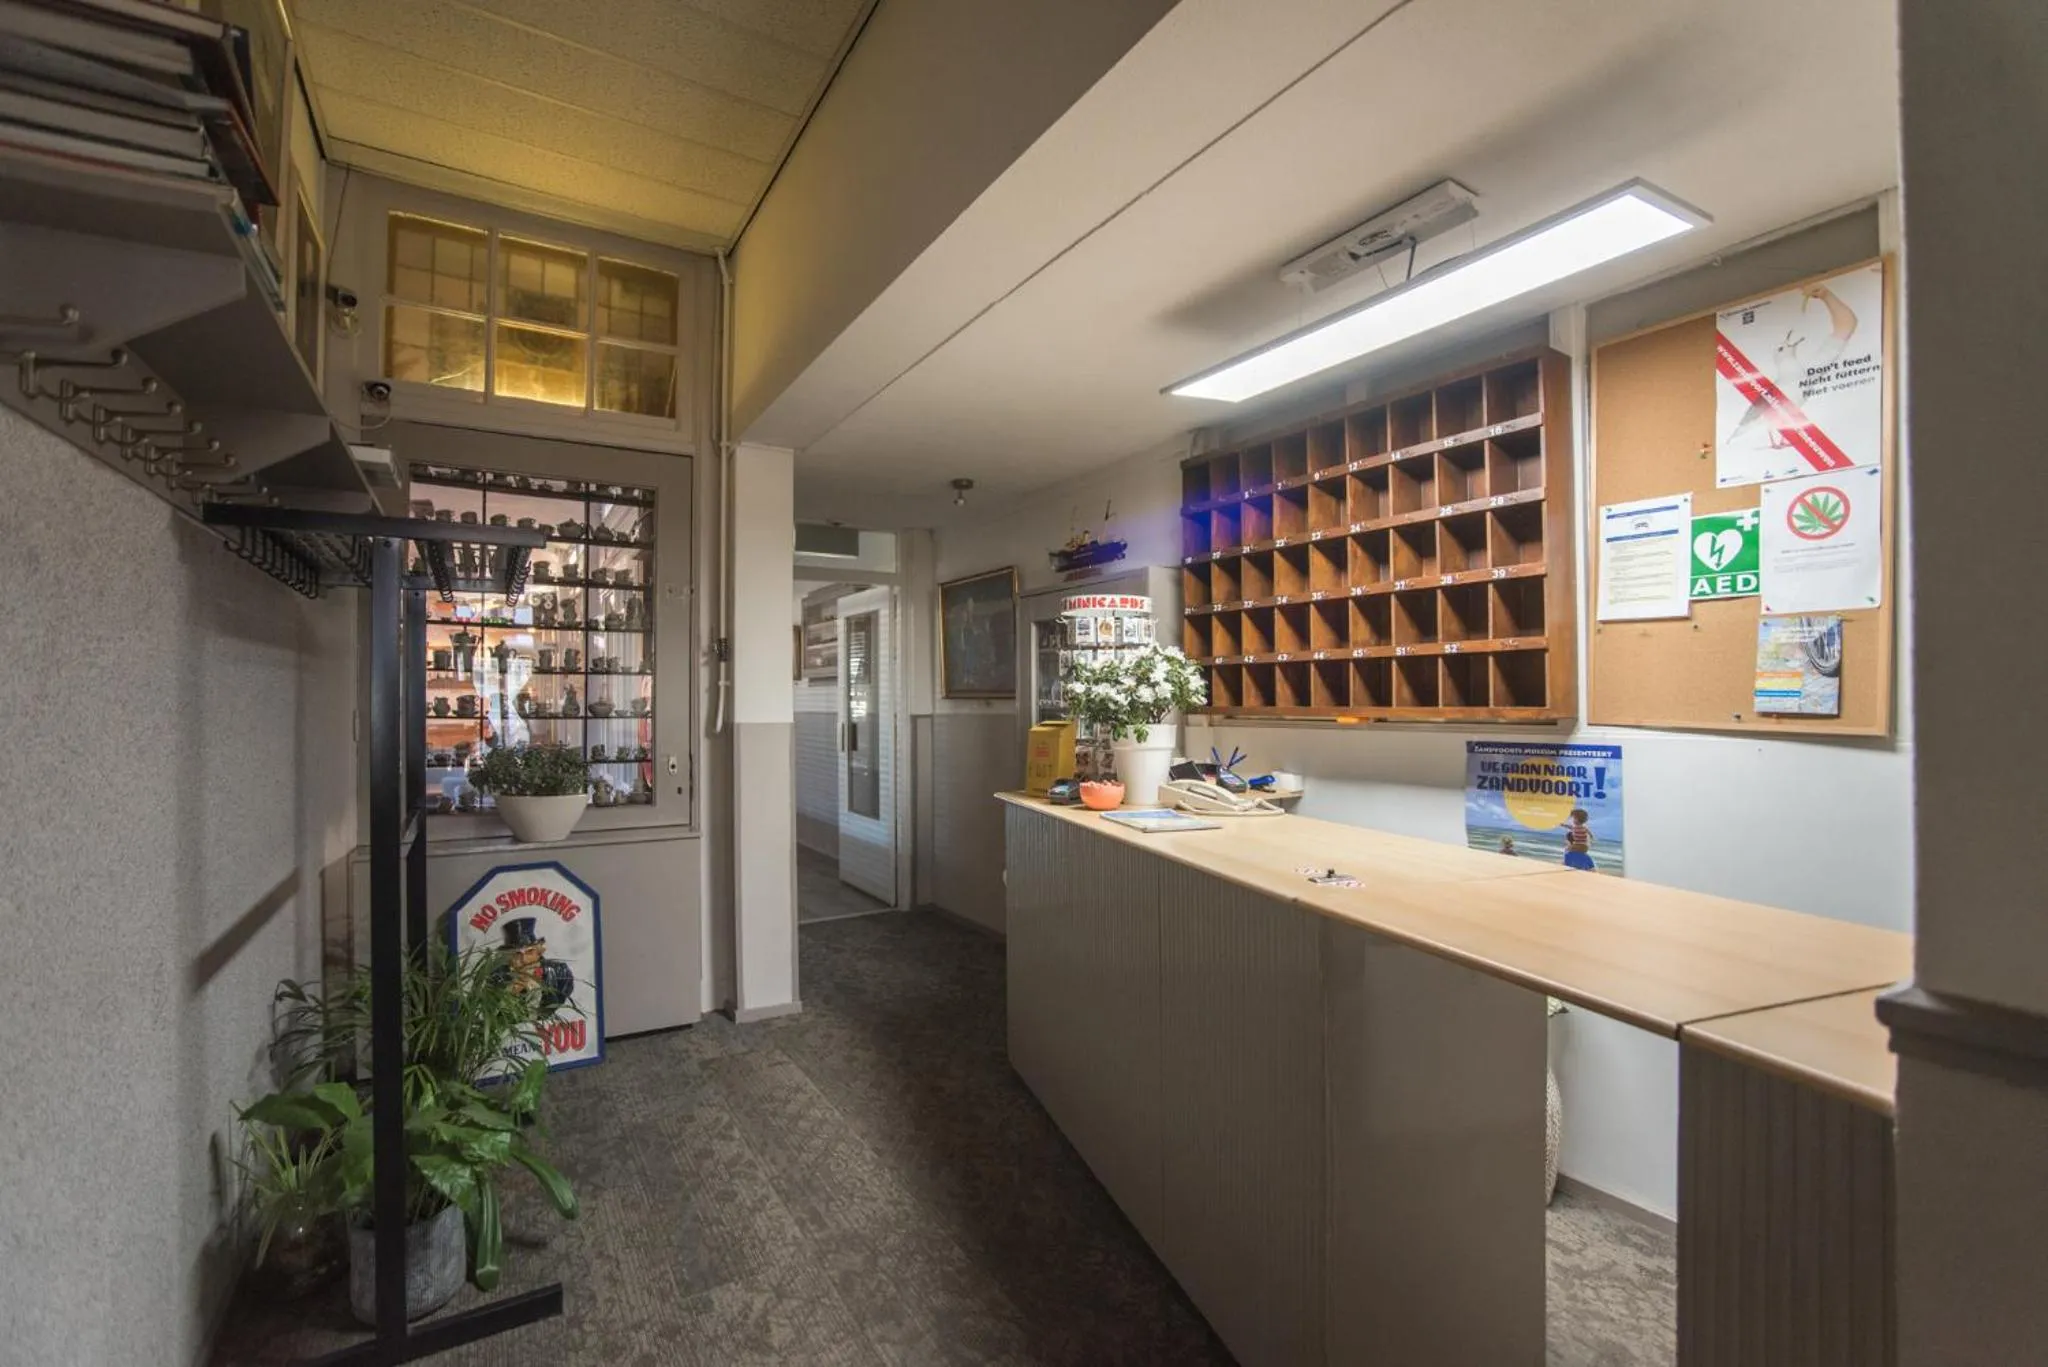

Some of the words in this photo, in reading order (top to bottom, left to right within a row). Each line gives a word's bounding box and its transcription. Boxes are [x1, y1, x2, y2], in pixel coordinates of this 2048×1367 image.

[1807, 362, 1838, 376] Don't
[1843, 355, 1871, 367] feed
[1799, 375, 1831, 388] Nicht
[1803, 386, 1828, 398] Niet
[1832, 377, 1875, 391] voeren
[1692, 574, 1758, 596] AED
[1558, 750, 1612, 758] PRESENTEERT
[1501, 762, 1542, 775] GAAN
[1544, 764, 1588, 779] NAAR
[1477, 767, 1607, 799] ZANDVOORT!
[469, 904, 498, 934] NO
[495, 887, 582, 922] SMOKING
[535, 1019, 587, 1055] YOU
